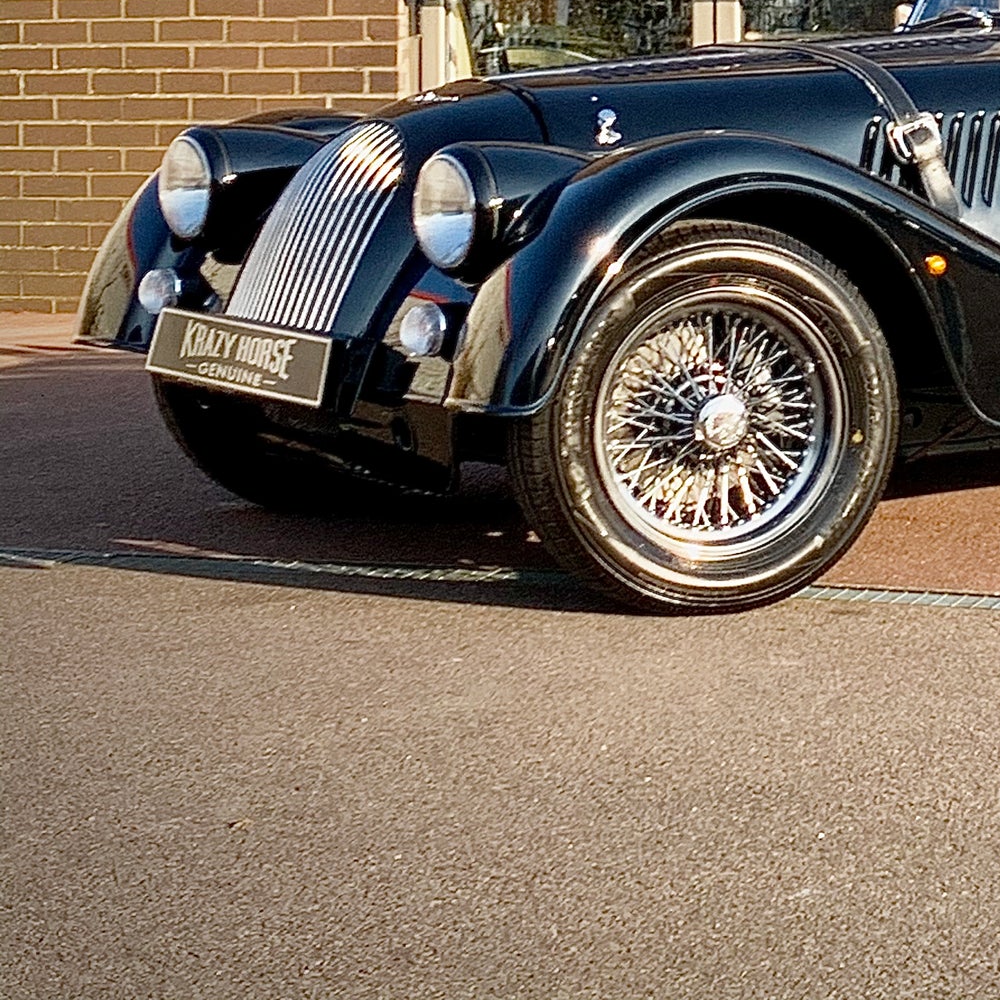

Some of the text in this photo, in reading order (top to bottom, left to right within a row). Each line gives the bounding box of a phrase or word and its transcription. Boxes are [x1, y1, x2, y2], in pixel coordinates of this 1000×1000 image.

[180, 319, 298, 380] KRAZY HORSE
[198, 362, 263, 387] GENUINE
